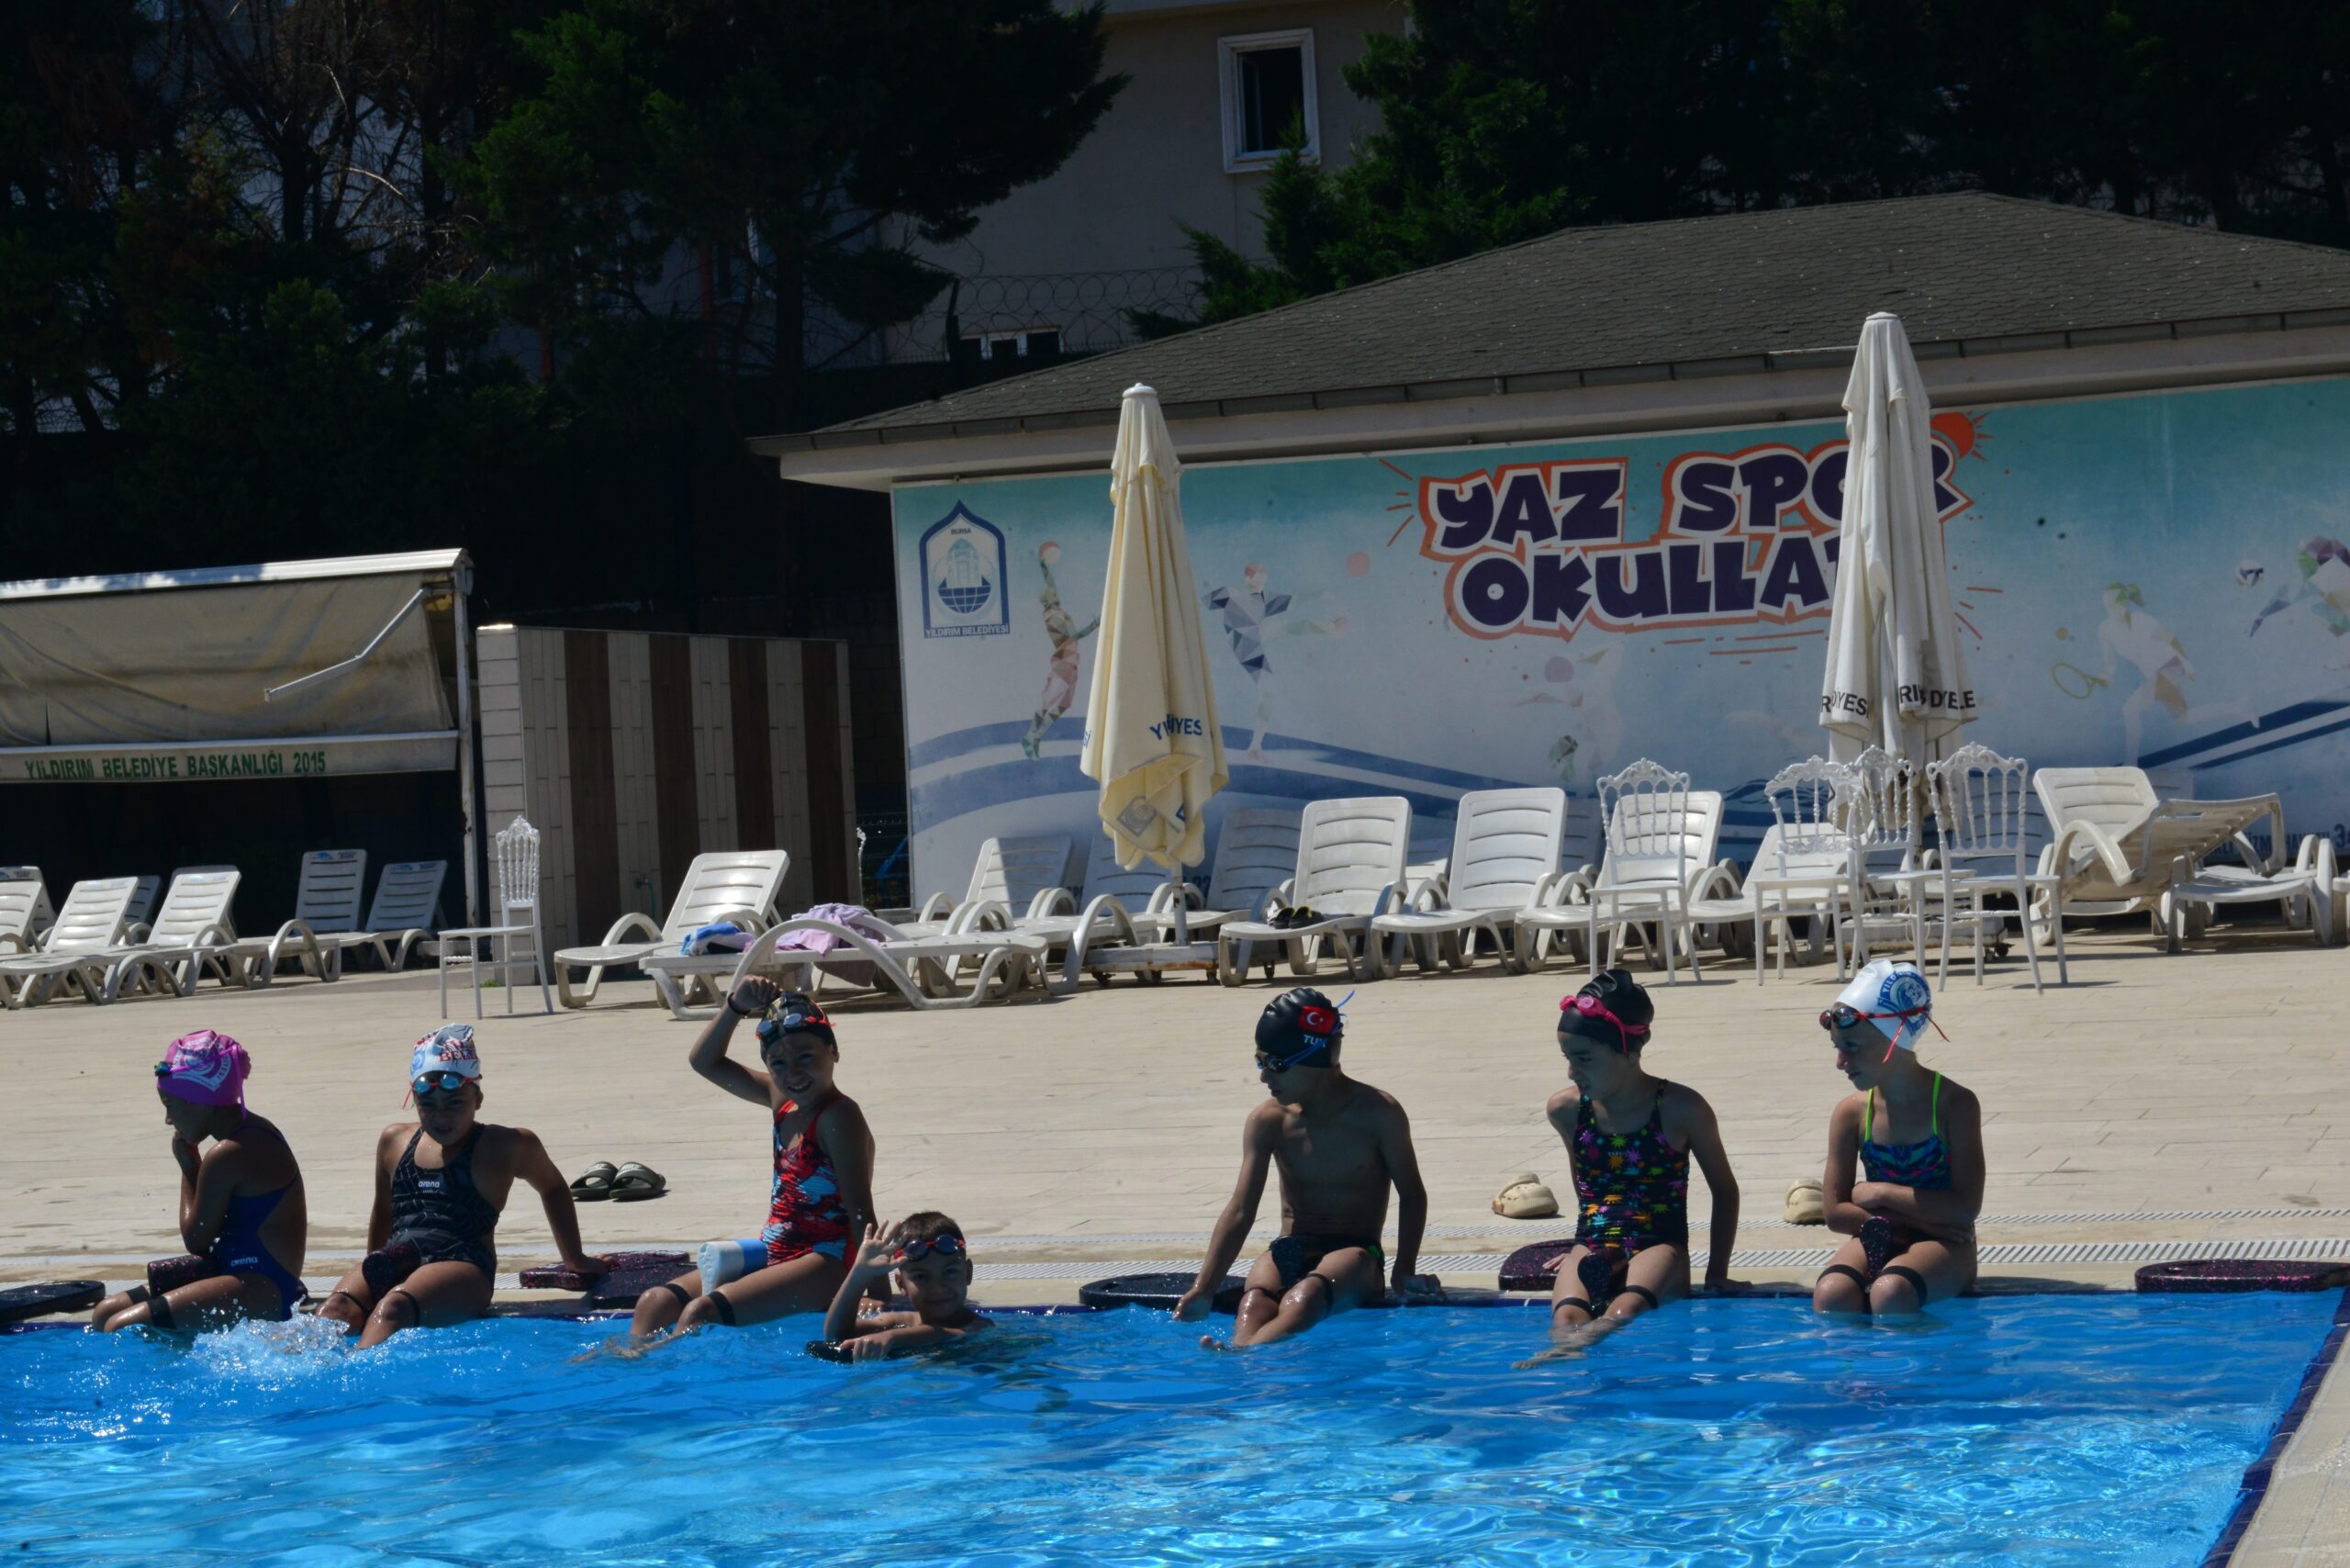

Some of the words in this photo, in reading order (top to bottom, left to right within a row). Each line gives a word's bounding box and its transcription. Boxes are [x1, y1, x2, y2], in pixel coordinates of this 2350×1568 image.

[1434, 467, 1623, 550] YAZ
[1460, 534, 1840, 628] OKULLA
[925, 627, 960, 638] YILDIRIM
[25, 758, 95, 779] YILDIRIM
[102, 753, 179, 778] BELEDİYE
[186, 749, 284, 778] BAŞKANLIĞI
[293, 751, 326, 774] 2015
[230, 1257, 258, 1267] arena
